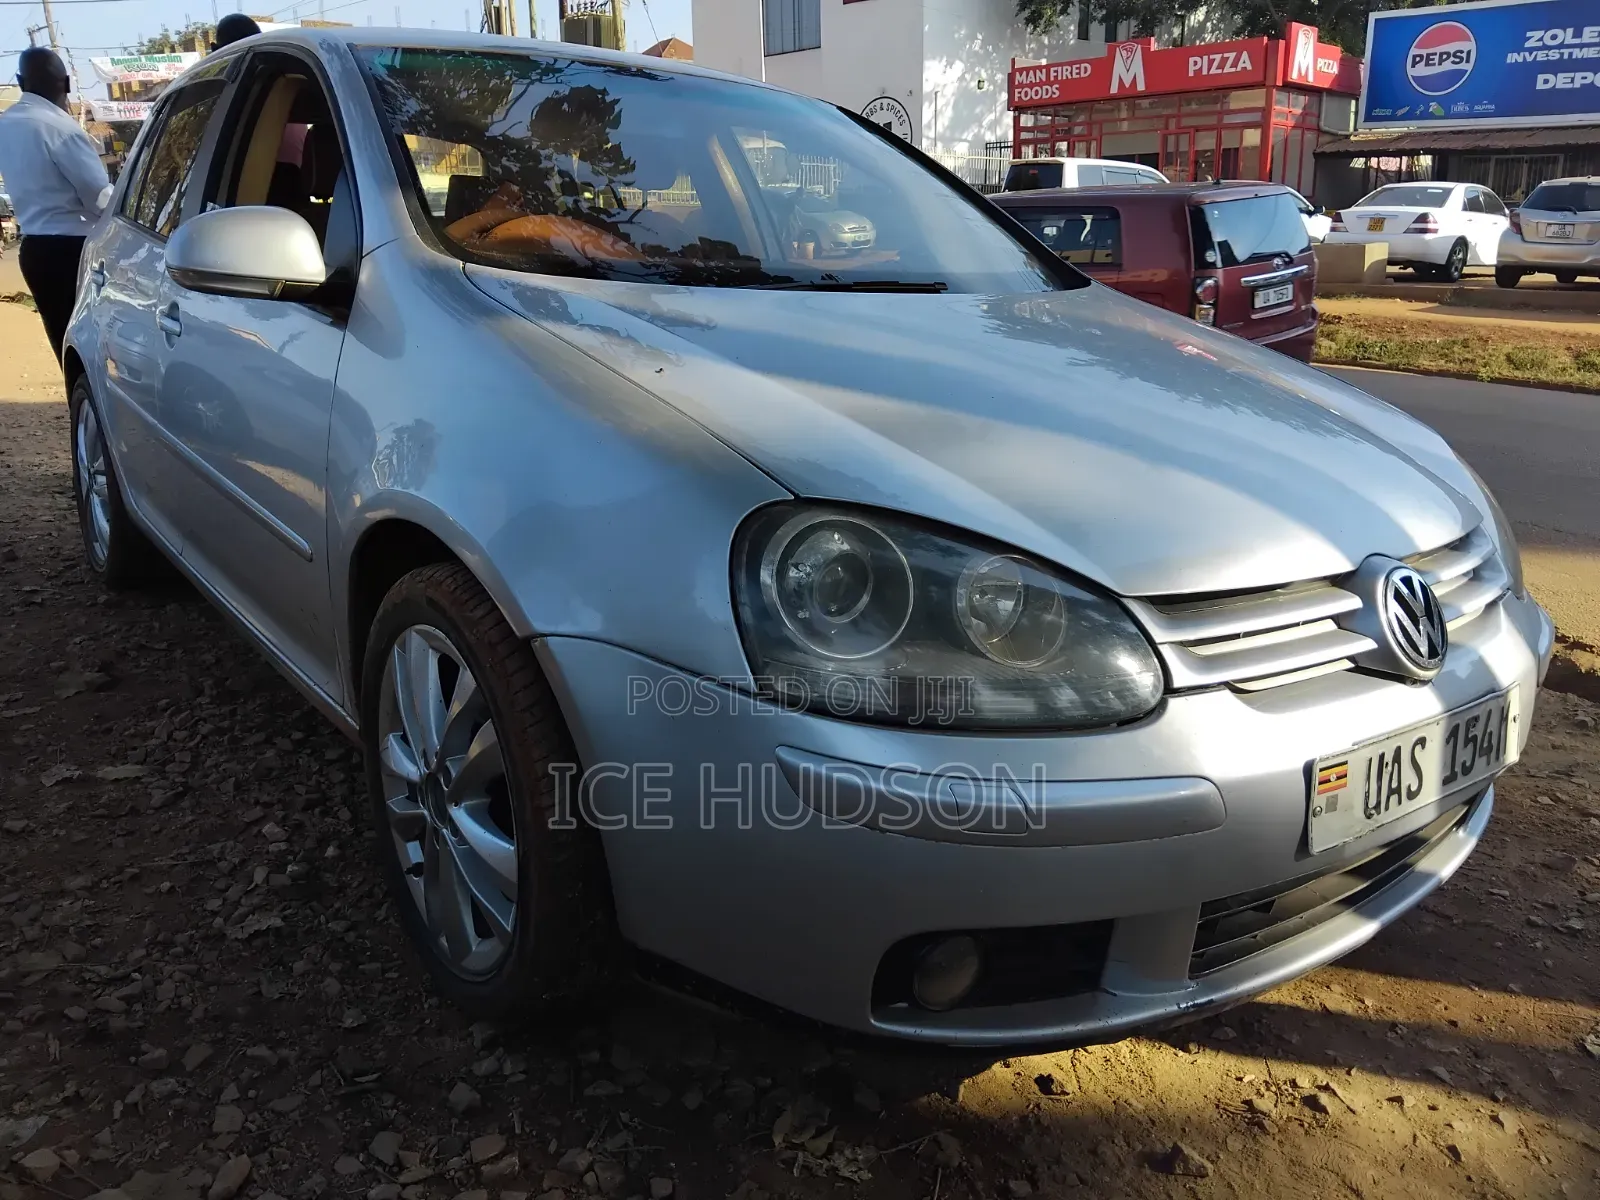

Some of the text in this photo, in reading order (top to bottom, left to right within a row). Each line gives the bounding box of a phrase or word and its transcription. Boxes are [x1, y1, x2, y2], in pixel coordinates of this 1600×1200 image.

[144, 54, 182, 64] Muslim
[1188, 51, 1252, 77] PIZZA
[1317, 58, 1338, 75] PIZZA
[1411, 49, 1472, 69] PEPSI
[1014, 63, 1092, 86] MAN FIRED
[1014, 84, 1060, 102] FOODS
[864, 102, 906, 126] RBS & SPICES
[1363, 736, 1427, 820] UAS
